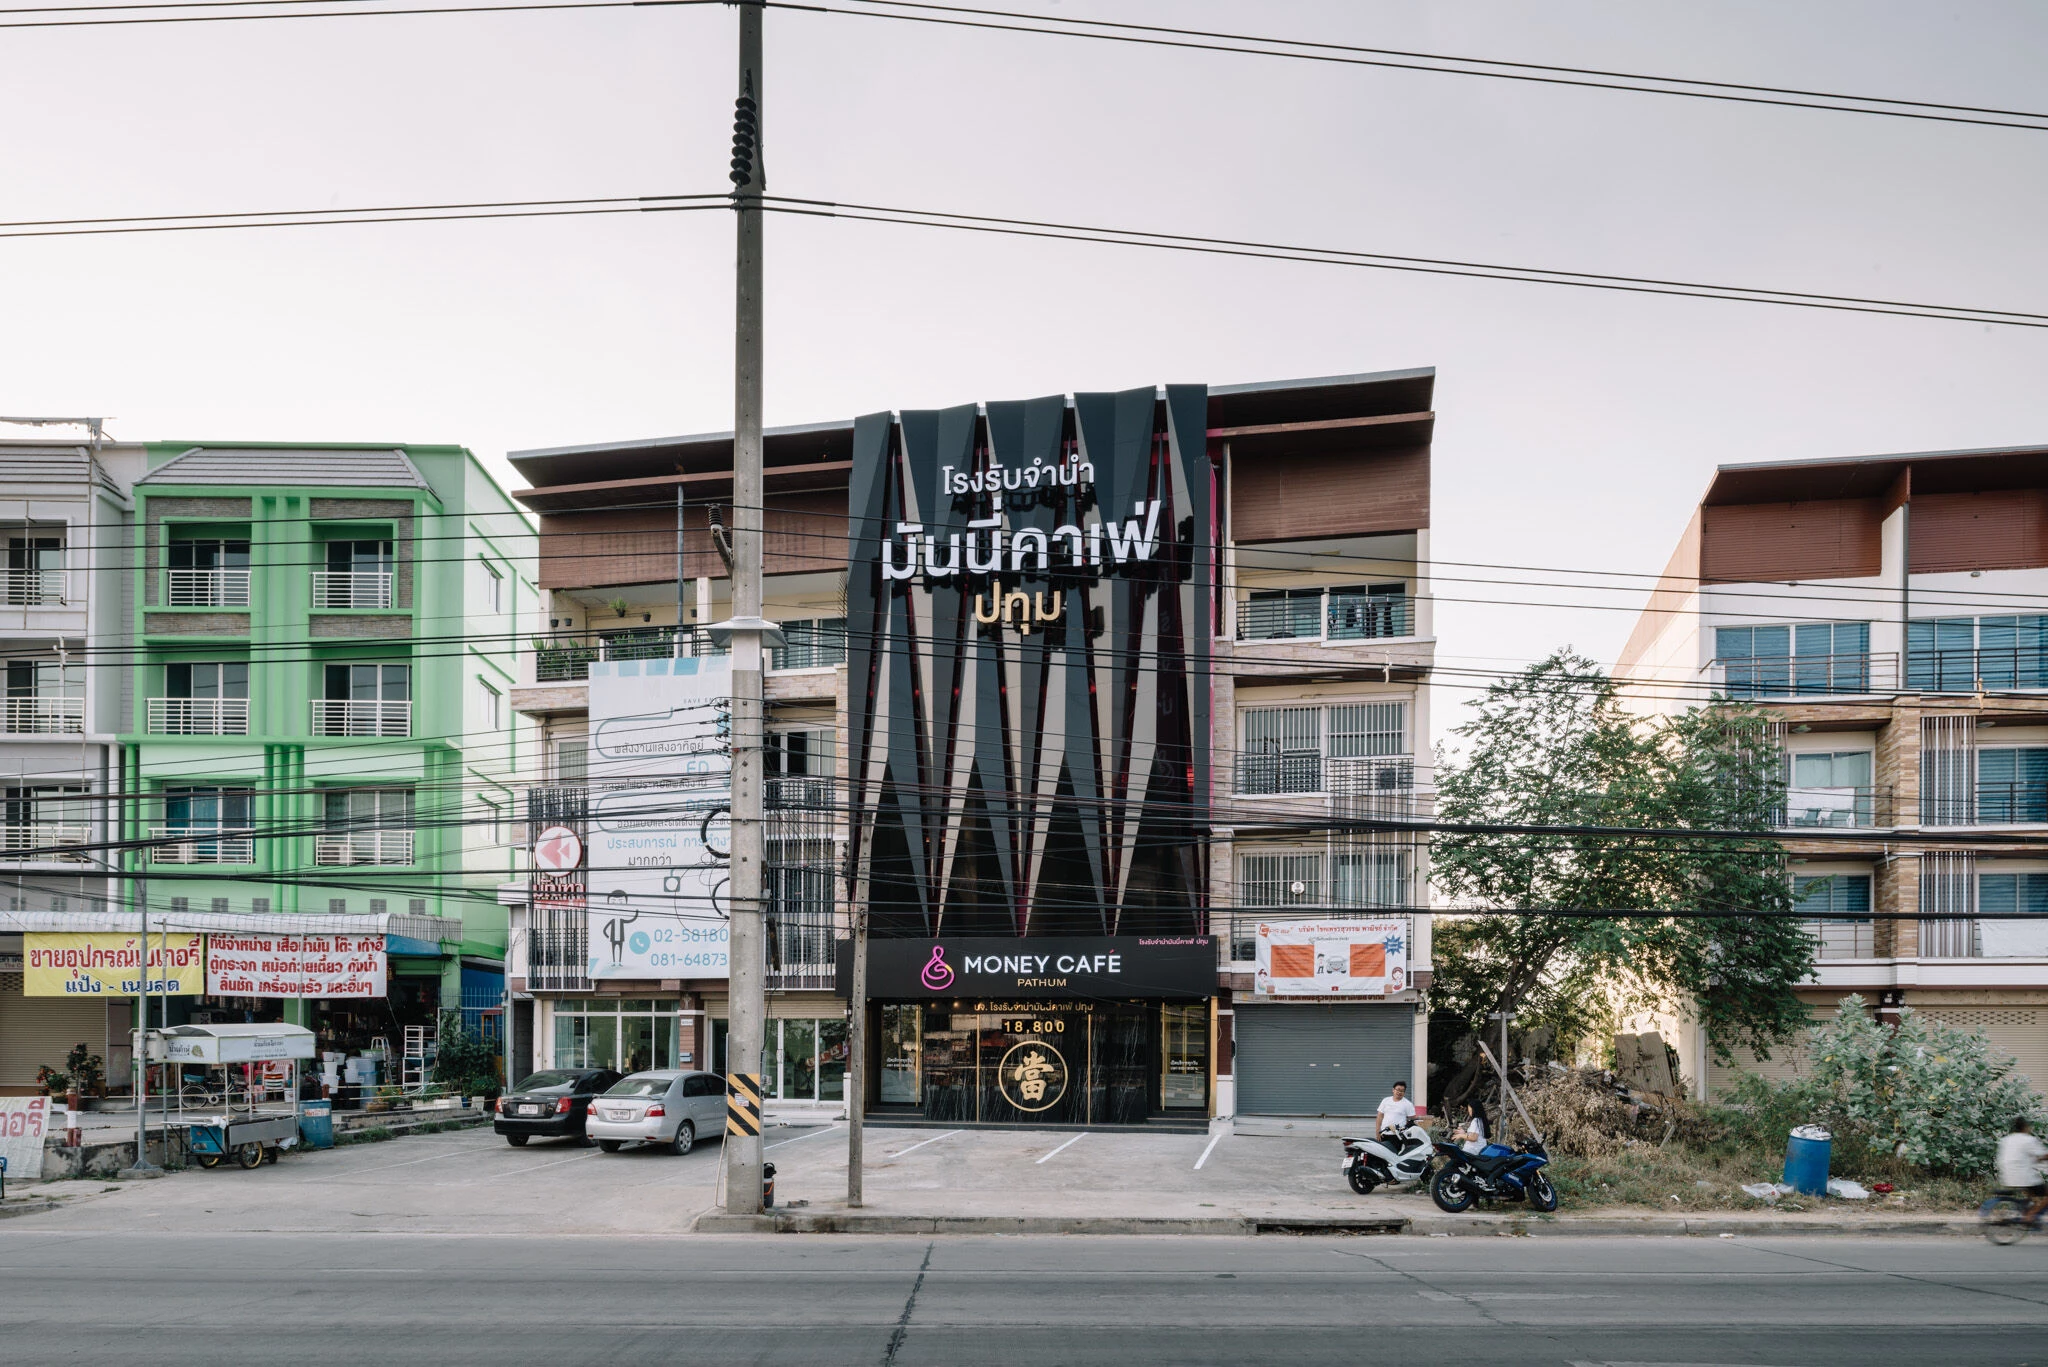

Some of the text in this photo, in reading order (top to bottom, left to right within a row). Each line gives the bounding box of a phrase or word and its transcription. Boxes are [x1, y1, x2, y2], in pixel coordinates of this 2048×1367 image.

[942, 454, 1095, 495] โรงรับจำนำ
[882, 497, 1162, 580] มันนี่คาเฟ่
[975, 581, 1062, 635] ปทุม
[607, 834, 677, 849] ประสบการณ์
[628, 851, 672, 866] มากกว่า
[1196, 938, 1209, 946] ปทุม
[210, 954, 257, 975] ตู้กระจก
[965, 949, 1121, 974] MONEY CAFÉ
[65, 975, 101, 993] แป้ง
[1017, 978, 1067, 987] PATHUM
[1075, 1001, 1094, 1013] ปทุม
[1004, 1021, 1065, 1034] 18,800
[1014, 1050, 1055, 1101] 當
